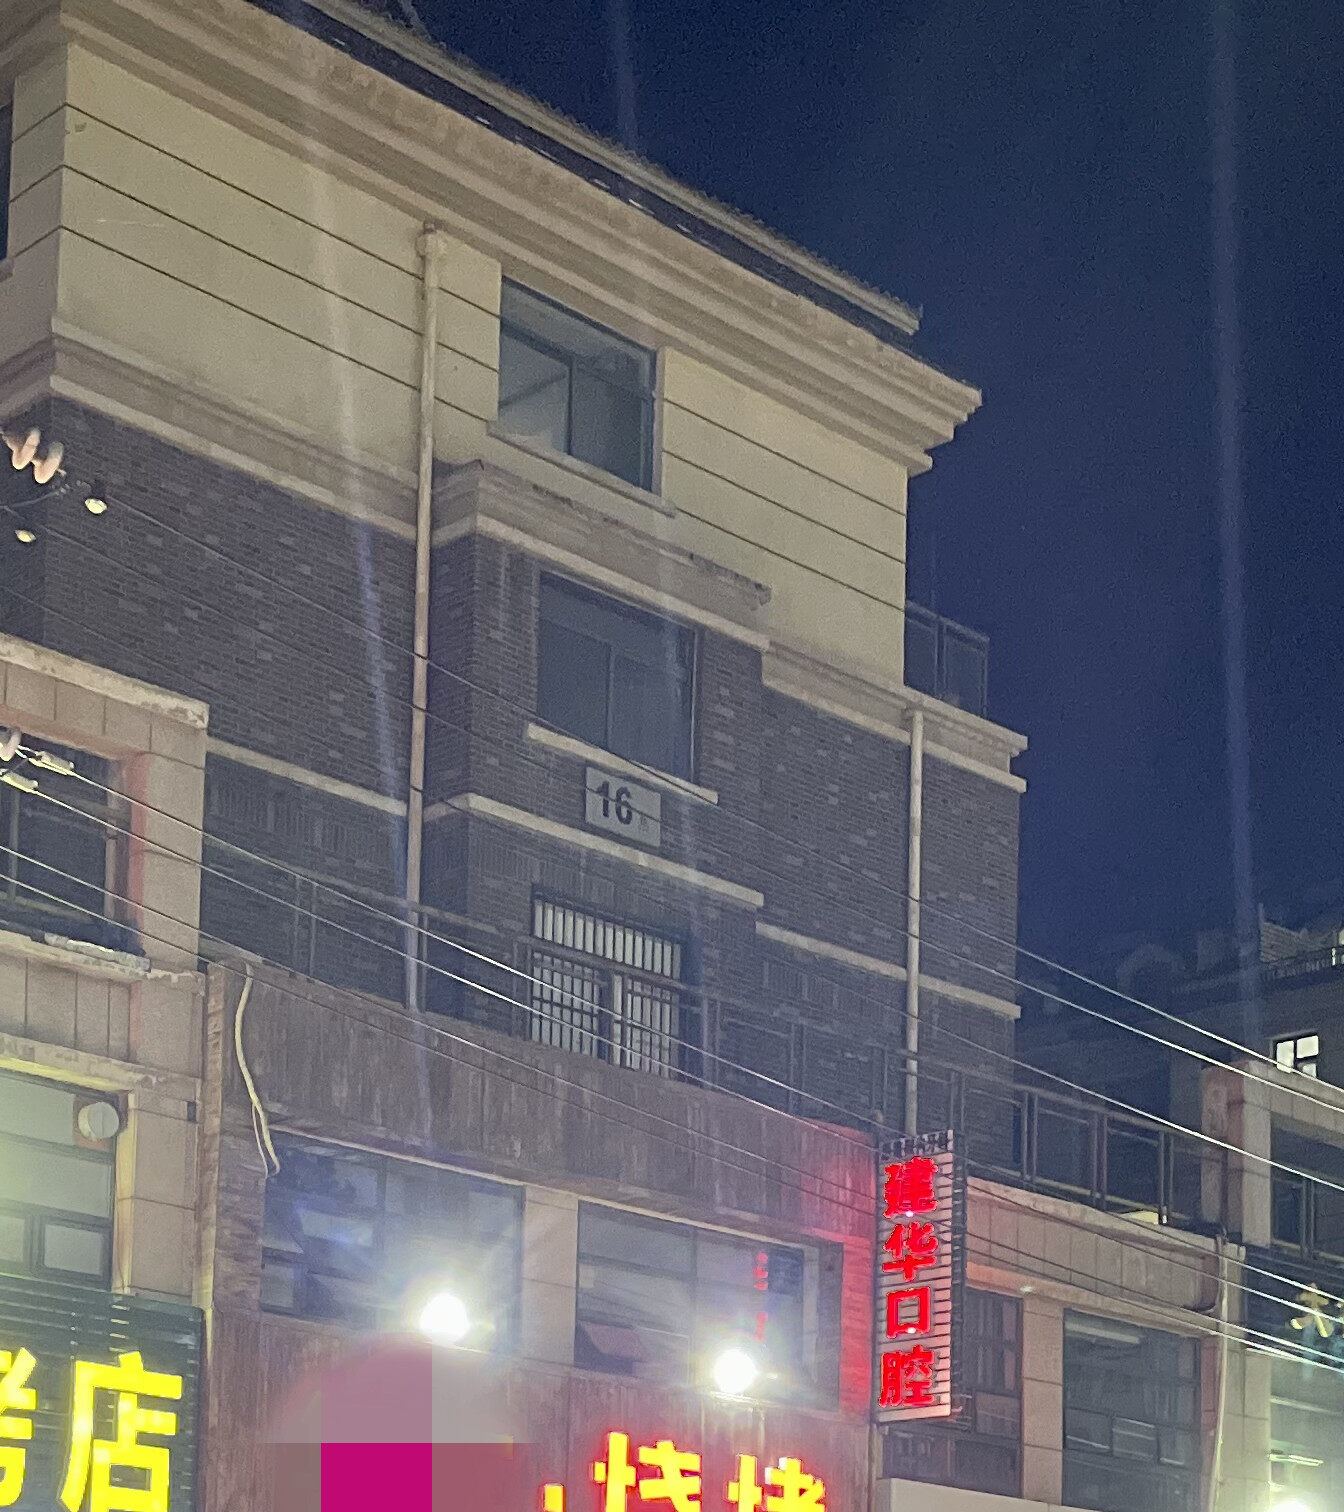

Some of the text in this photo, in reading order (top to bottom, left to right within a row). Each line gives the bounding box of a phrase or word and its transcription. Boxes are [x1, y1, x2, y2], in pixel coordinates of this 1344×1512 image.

[597, 781, 632, 825] 16
[879, 1156, 939, 1407] 建华口腔
